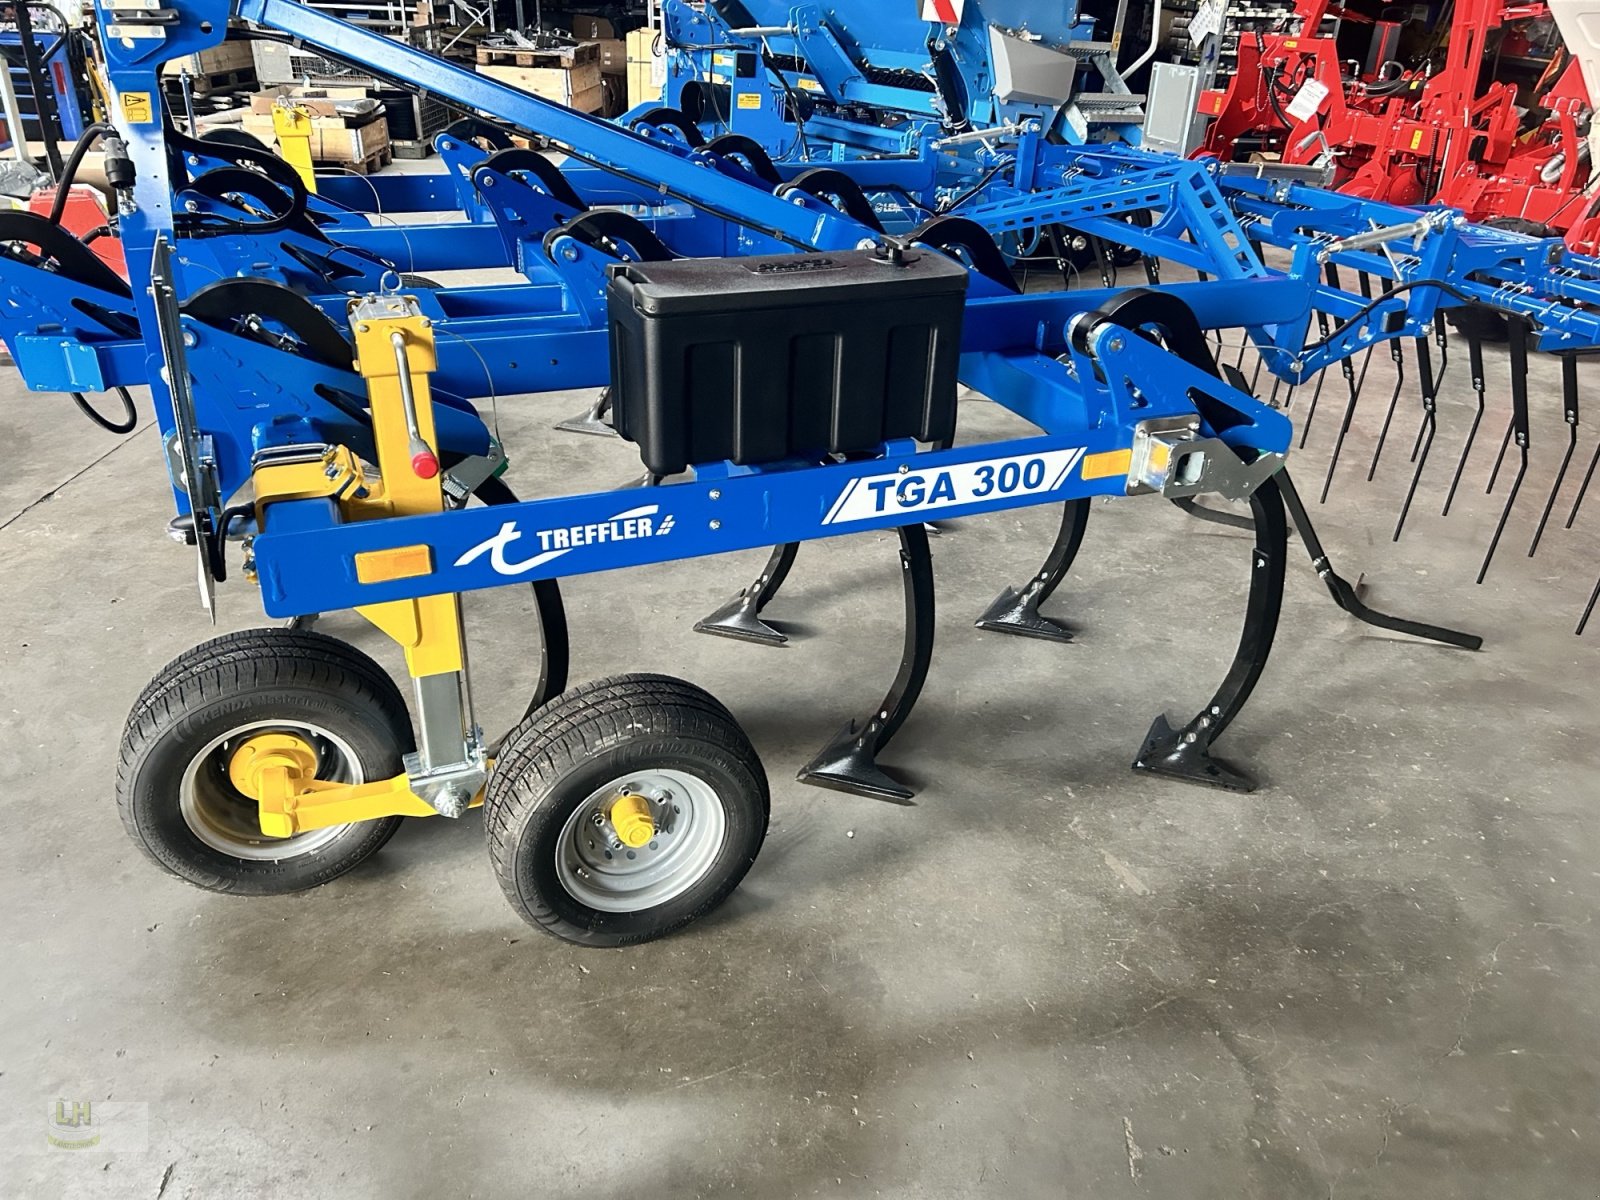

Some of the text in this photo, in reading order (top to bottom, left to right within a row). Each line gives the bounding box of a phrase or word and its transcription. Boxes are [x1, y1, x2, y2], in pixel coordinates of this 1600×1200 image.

[867, 458, 1045, 512] TGA 300
[536, 517, 652, 551] TREFFLER
[200, 698, 254, 724] KENDA
